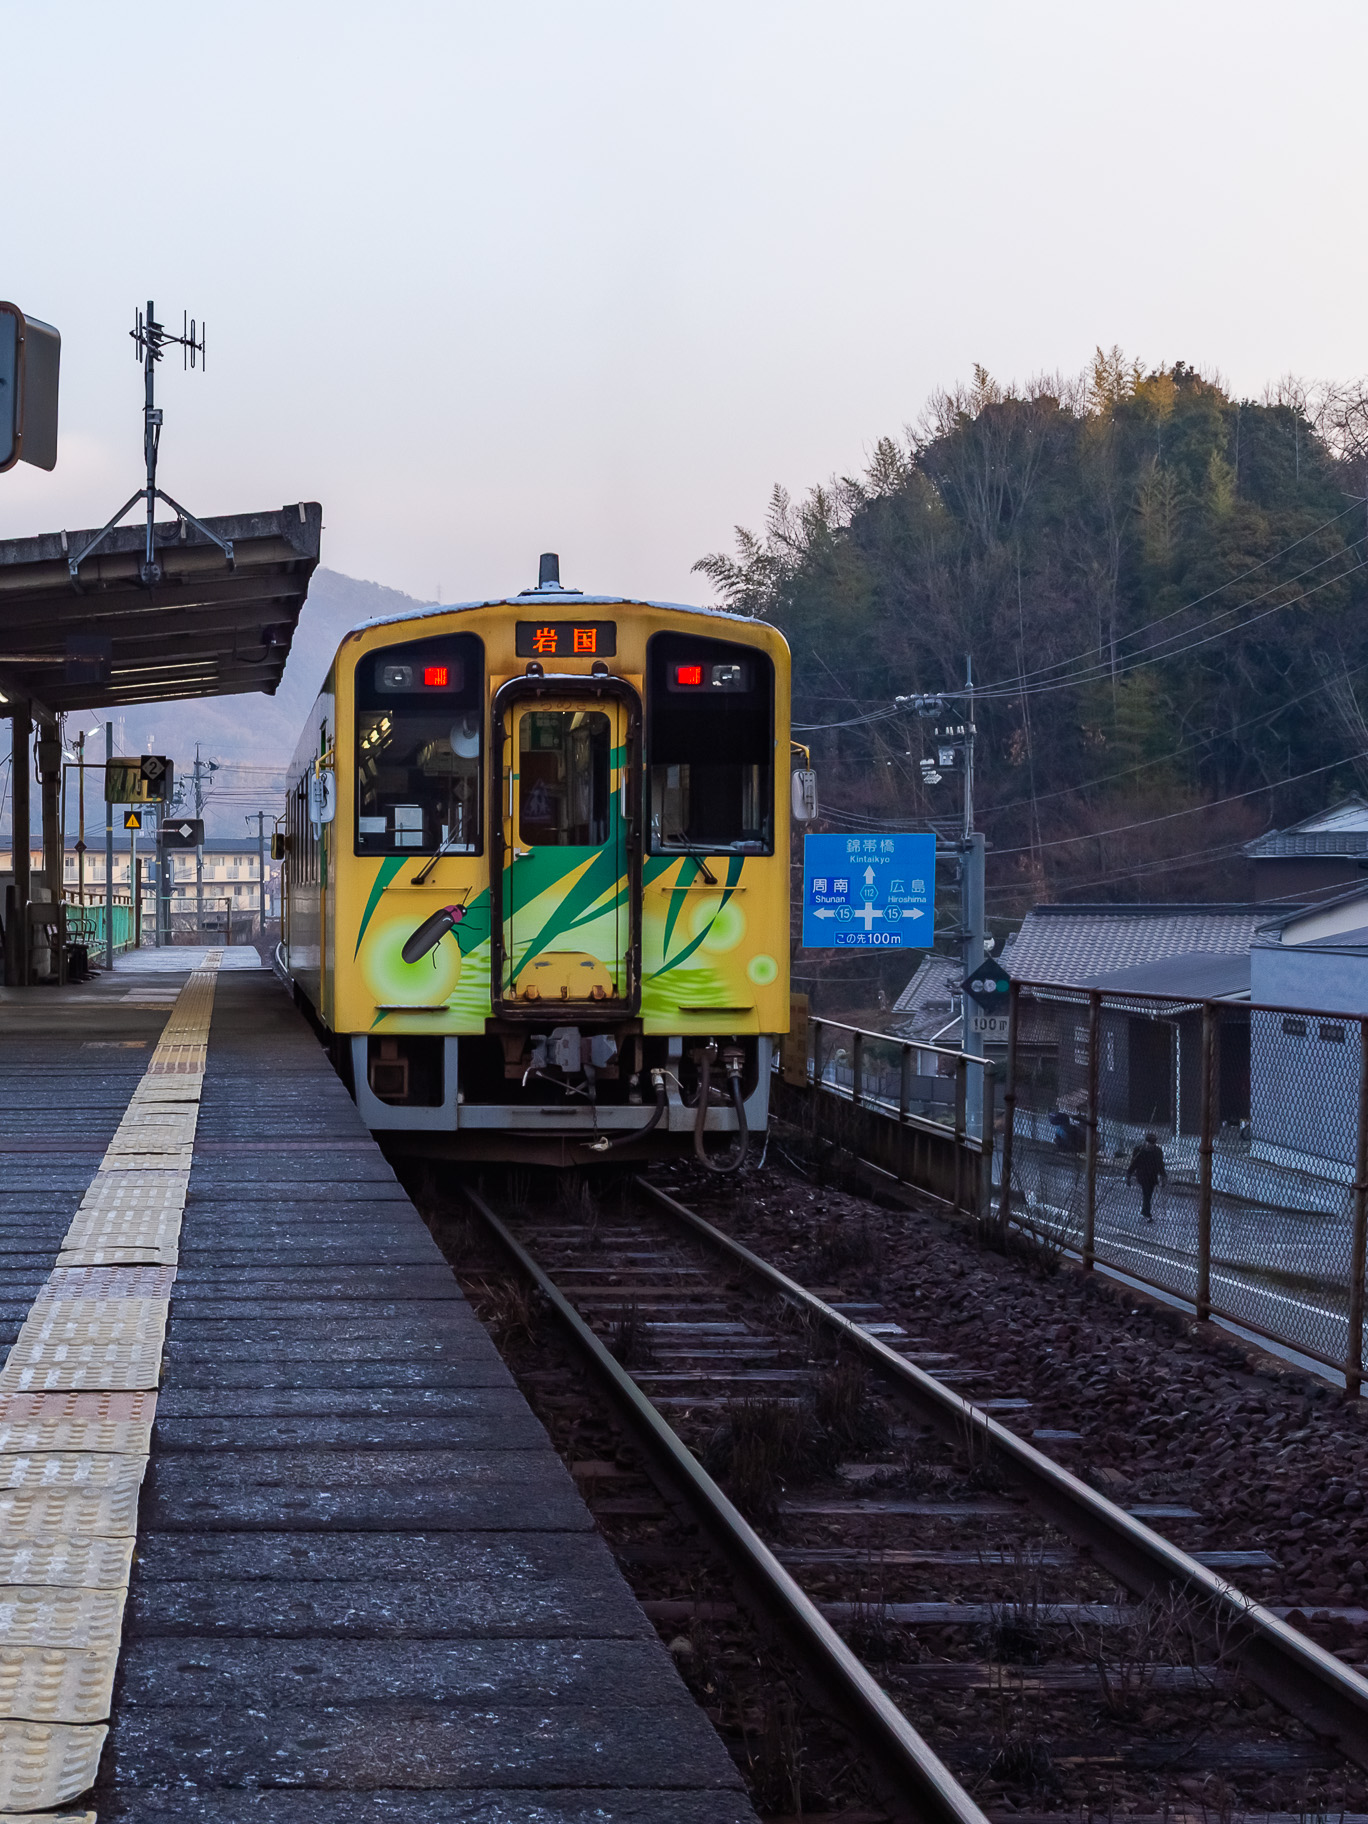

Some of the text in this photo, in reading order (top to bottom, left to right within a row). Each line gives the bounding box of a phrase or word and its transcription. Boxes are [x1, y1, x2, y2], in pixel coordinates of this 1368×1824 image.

[532, 628, 597, 652] 岩国
[148, 761, 158, 775] 2
[846, 838, 895, 853] 錦帯橋
[849, 855, 890, 864] Kintaikyo
[812, 878, 849, 894] 周南
[889, 878, 926, 894] 広島
[864, 888, 874, 897] 112
[815, 895, 846, 903] Shunan
[887, 895, 927, 903] Hiroshima
[839, 908, 850, 919] 15
[887, 908, 898, 919] 15
